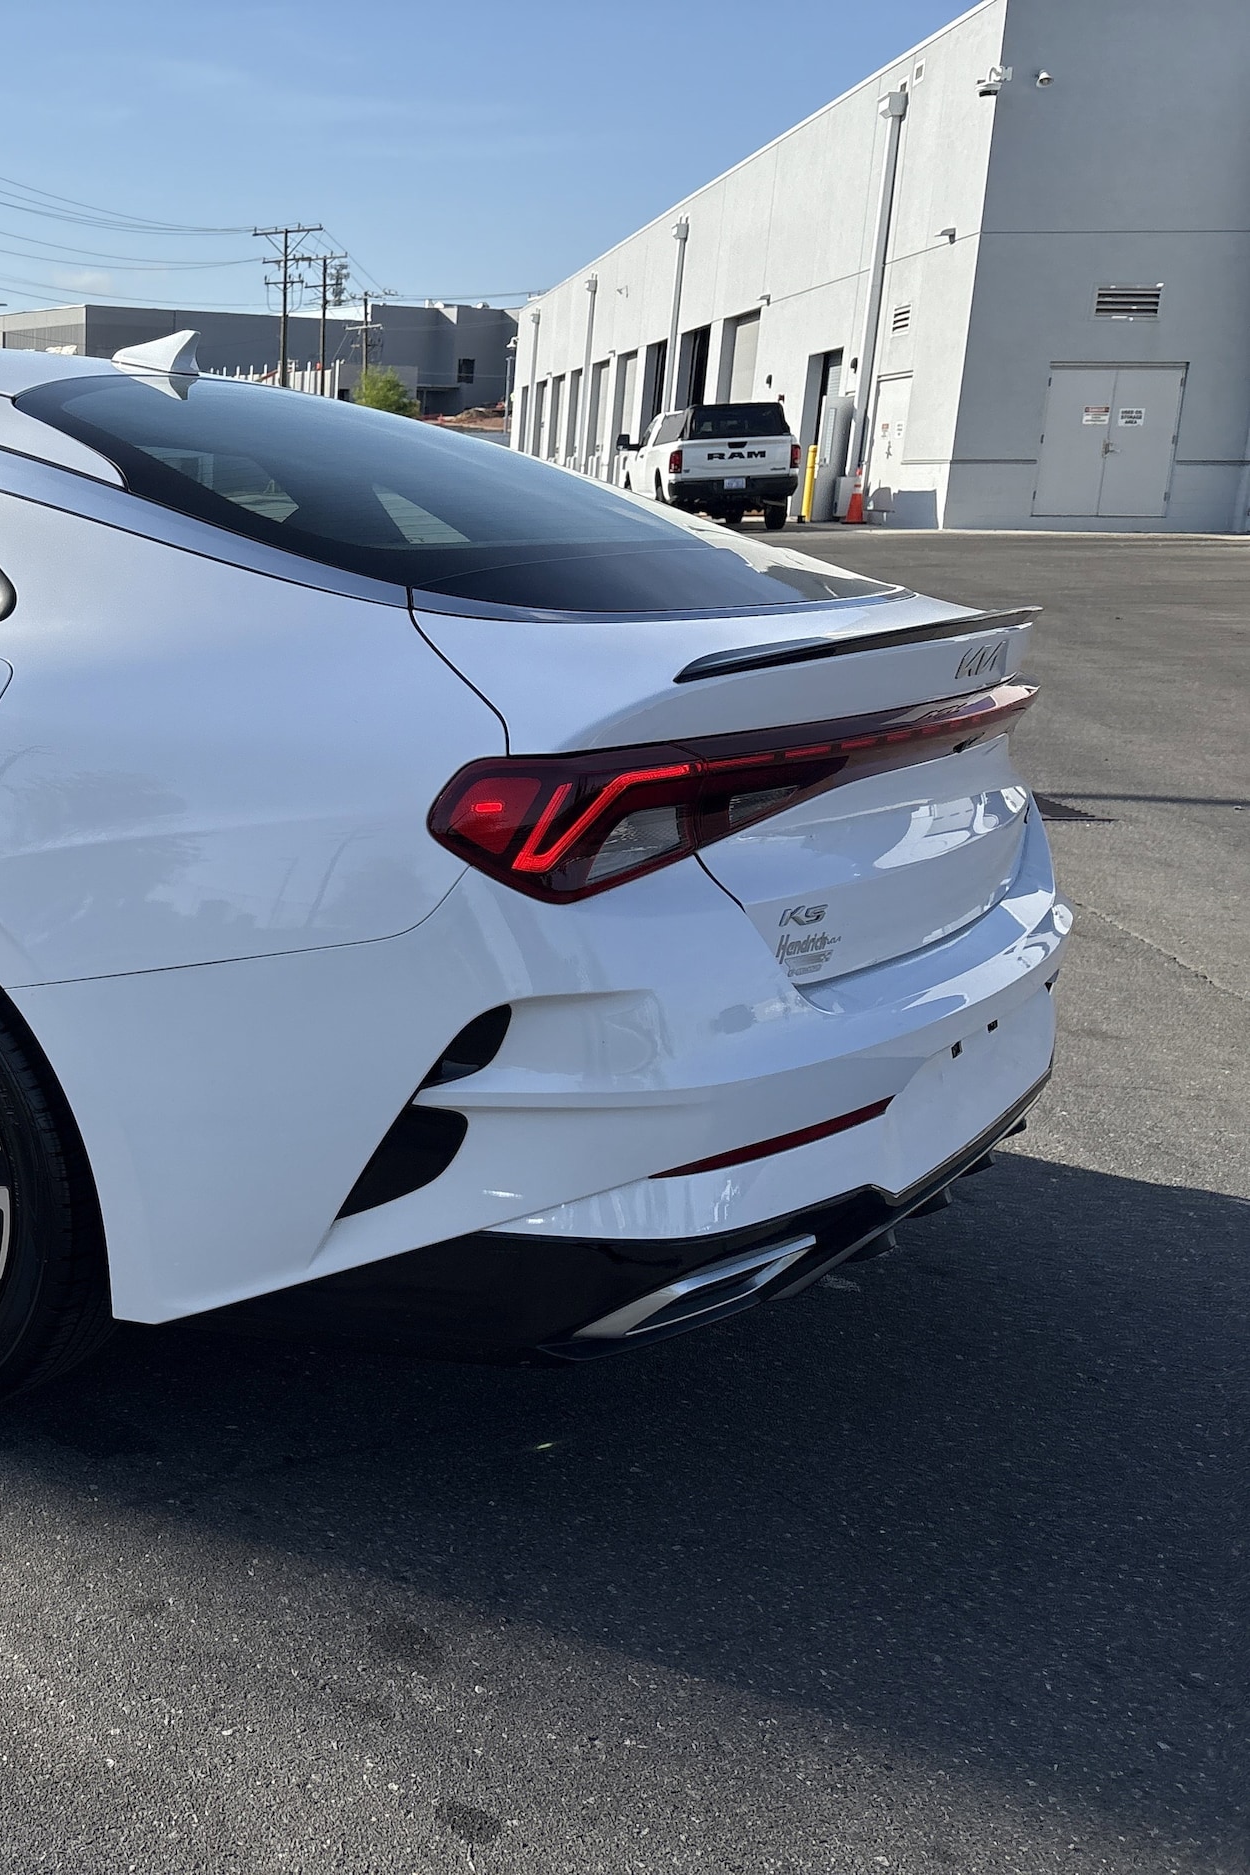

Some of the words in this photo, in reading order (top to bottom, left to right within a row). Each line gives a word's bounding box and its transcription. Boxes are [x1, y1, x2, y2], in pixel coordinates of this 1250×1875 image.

[707, 450, 766, 460] RAM
[955, 640, 1007, 679] KIA
[778, 904, 828, 927] K5
